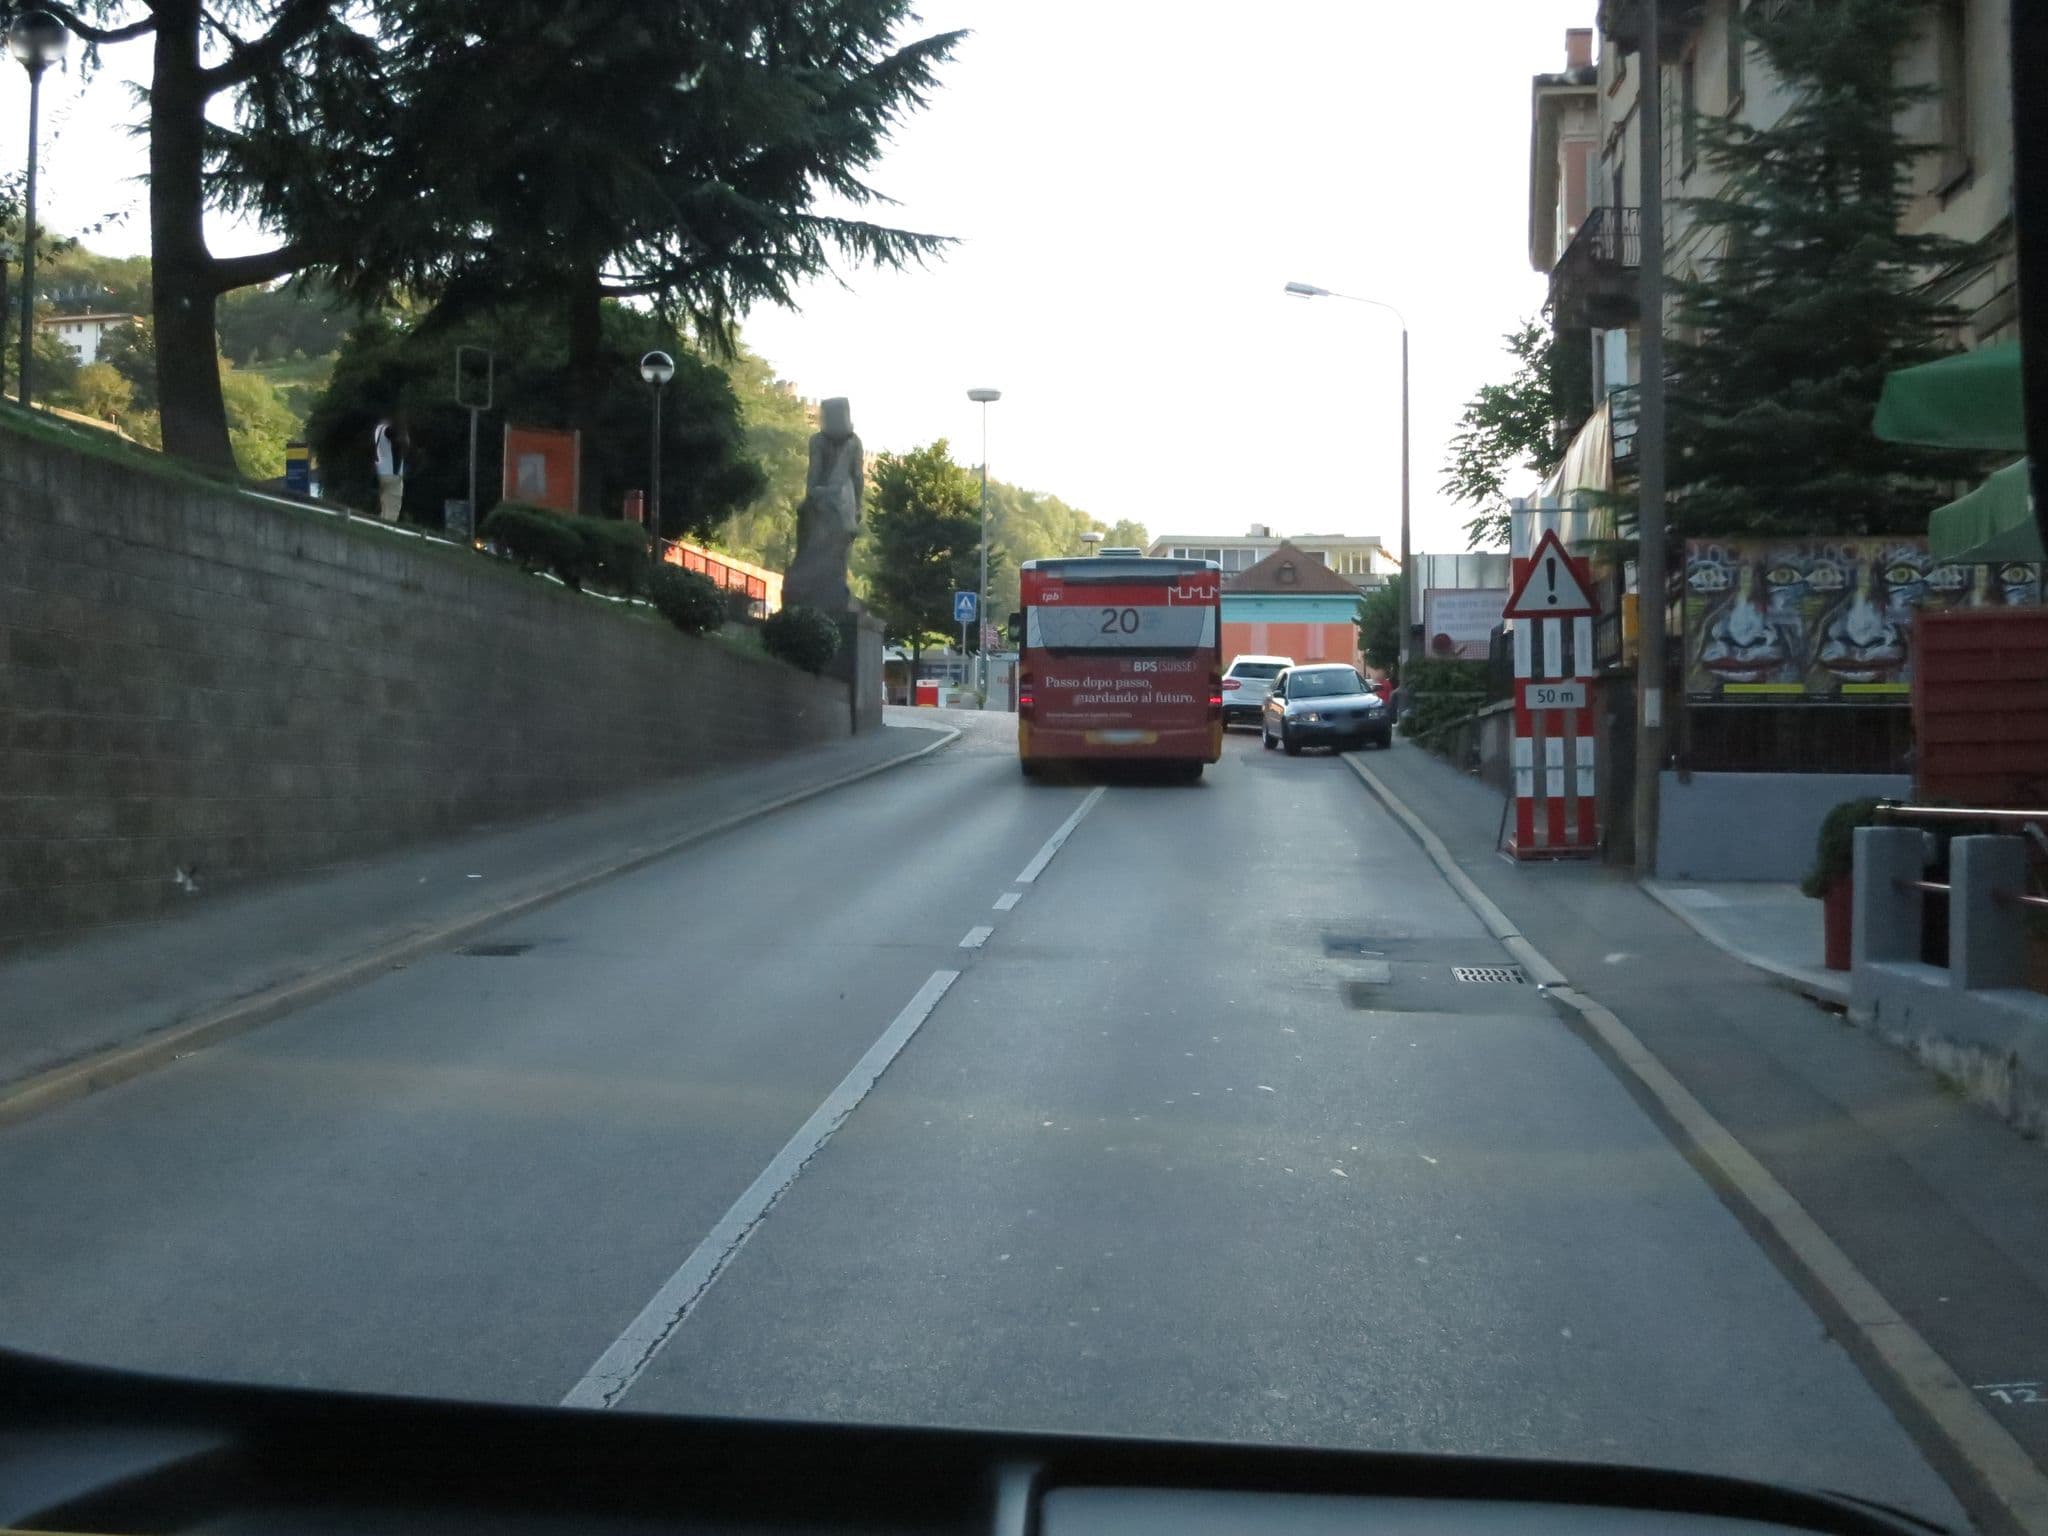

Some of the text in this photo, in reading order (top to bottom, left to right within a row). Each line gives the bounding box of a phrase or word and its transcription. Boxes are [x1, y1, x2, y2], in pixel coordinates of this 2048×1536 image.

[1101, 608, 1139, 634] 20
[1134, 661, 1158, 672] BPS
[1045, 677, 1152, 691] Passo dopo passo,
[1141, 692, 1152, 704] al
[1155, 692, 1197, 704] futuro.
[1537, 689, 1574, 703] 50 m
